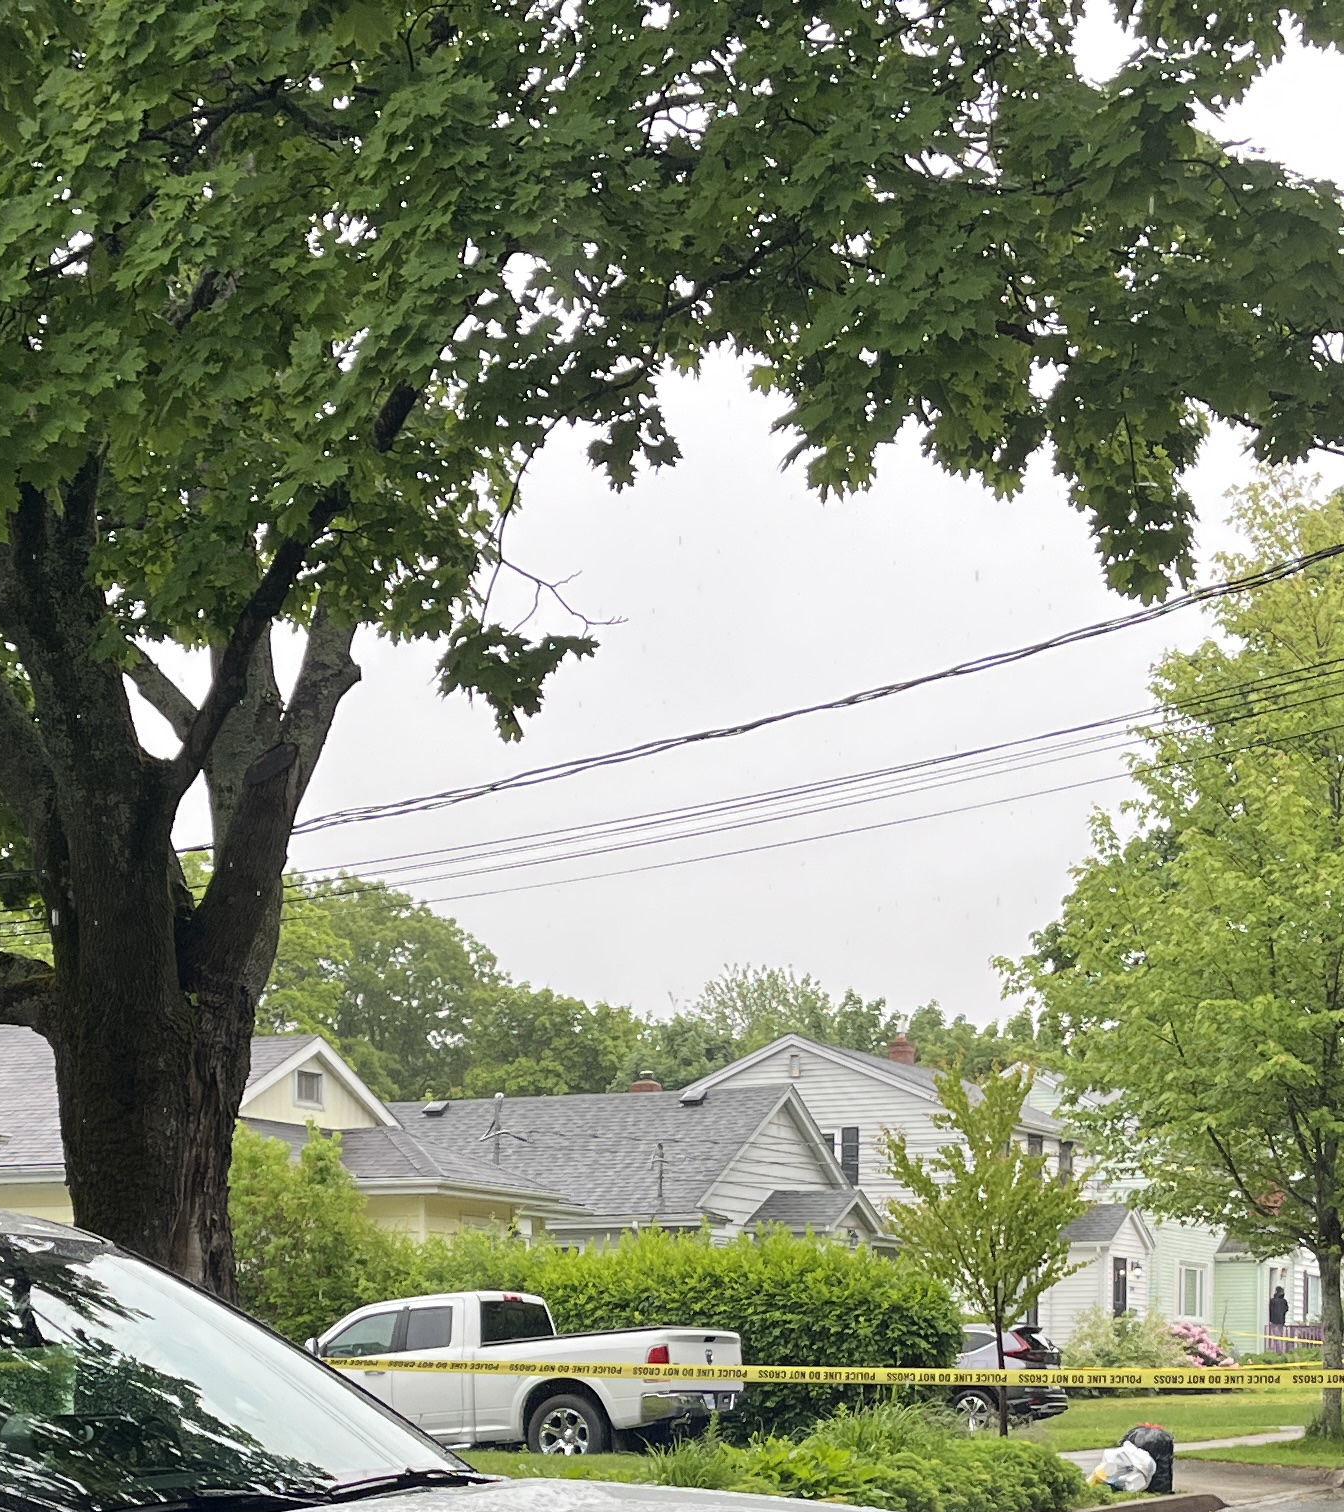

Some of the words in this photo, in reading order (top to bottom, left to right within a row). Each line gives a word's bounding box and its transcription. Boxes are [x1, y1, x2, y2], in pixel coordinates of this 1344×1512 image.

[470, 1363, 499, 1371] POLICE
[592, 1366, 622, 1374] POLICE
[633, 1367, 660, 1376] CROSS
[663, 1368, 679, 1376] NOT
[682, 1368, 693, 1377] DO
[696, 1368, 715, 1377] LINE
[717, 1369, 747, 1378] POLICE
[758, 1370, 787, 1379] CROSS
[789, 1371, 805, 1379] NOT
[809, 1371, 820, 1379] DO
[824, 1372, 842, 1380] LINE
[845, 1372, 875, 1380] POLICE
[887, 1372, 915, 1381] CROSS
[918, 1374, 935, 1382] NOT
[939, 1374, 950, 1382] DO
[976, 1374, 1007, 1382] POLICE
[1018, 1374, 1048, 1383] CROSS
[1051, 1375, 1068, 1383] NOT
[1072, 1375, 1083, 1383] DO
[1087, 1375, 1106, 1383] LINE
[1110, 1375, 1141, 1384] POLICE
[1154, 1375, 1184, 1384] CROSS
[1187, 1376, 1205, 1384] NOT
[1247, 1375, 1280, 1384] POLICE
[1292, 1375, 1323, 1383] CROSS
[1327, 1375, 1344, 1383] NOT
